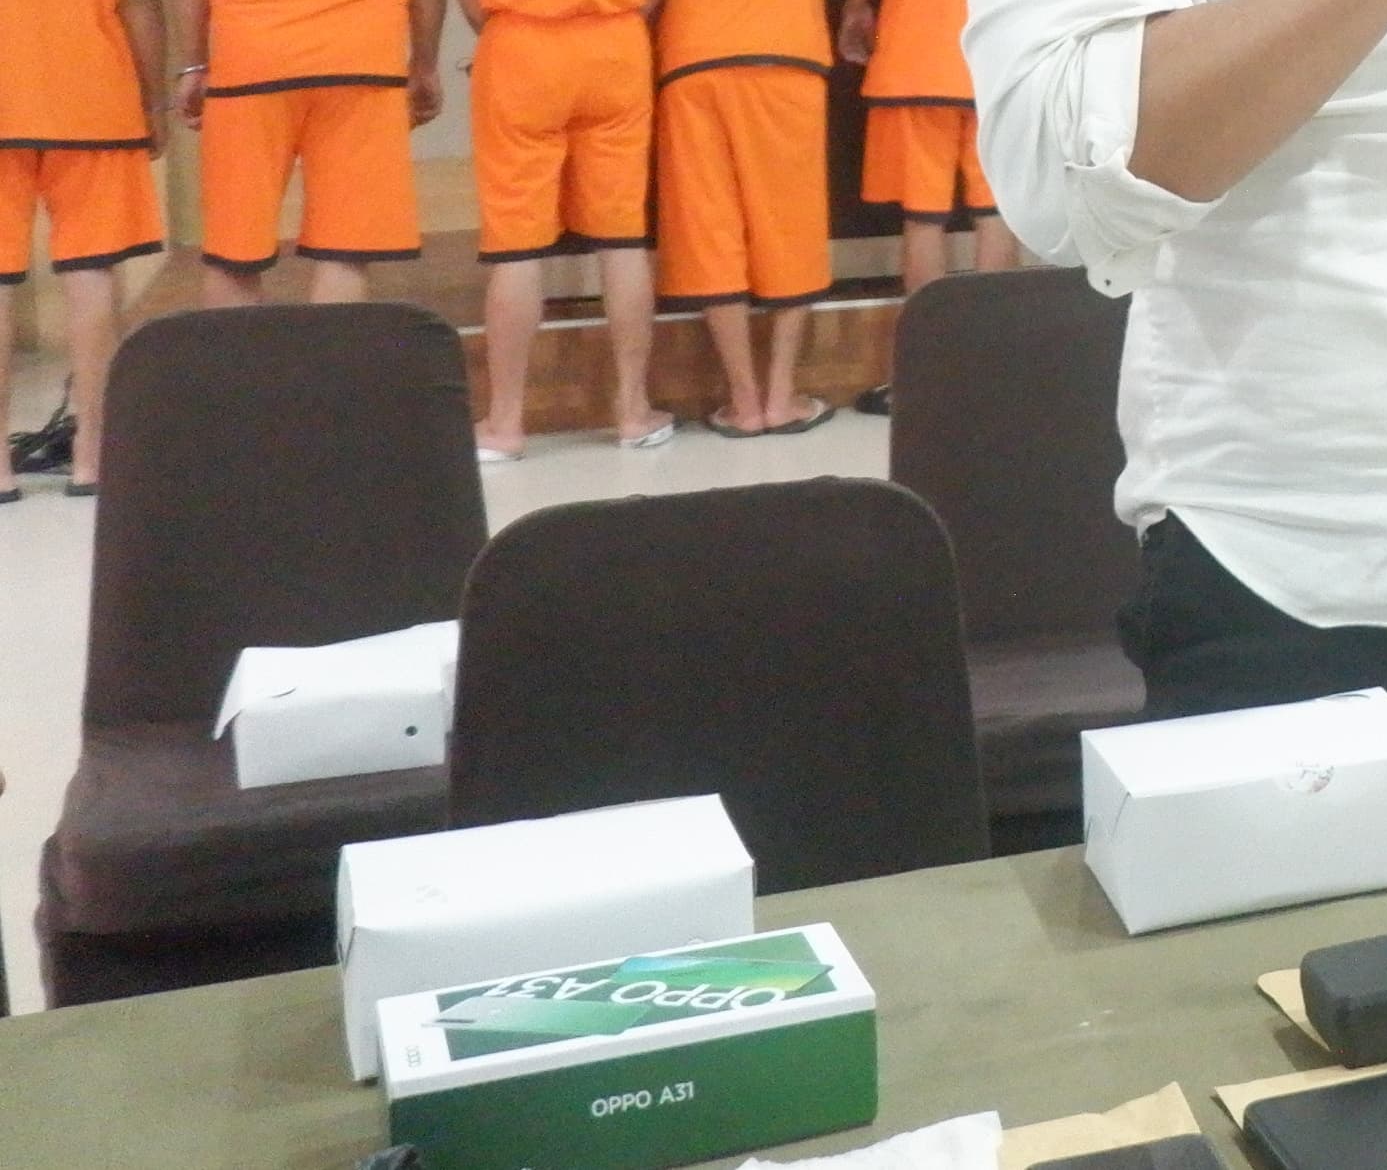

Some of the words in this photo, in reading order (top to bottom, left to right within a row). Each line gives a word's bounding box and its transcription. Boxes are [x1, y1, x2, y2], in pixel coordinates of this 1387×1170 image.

[610, 979, 787, 1010] OPPO
[591, 1089, 651, 1118] OPPO
[659, 1081, 694, 1105] A31
